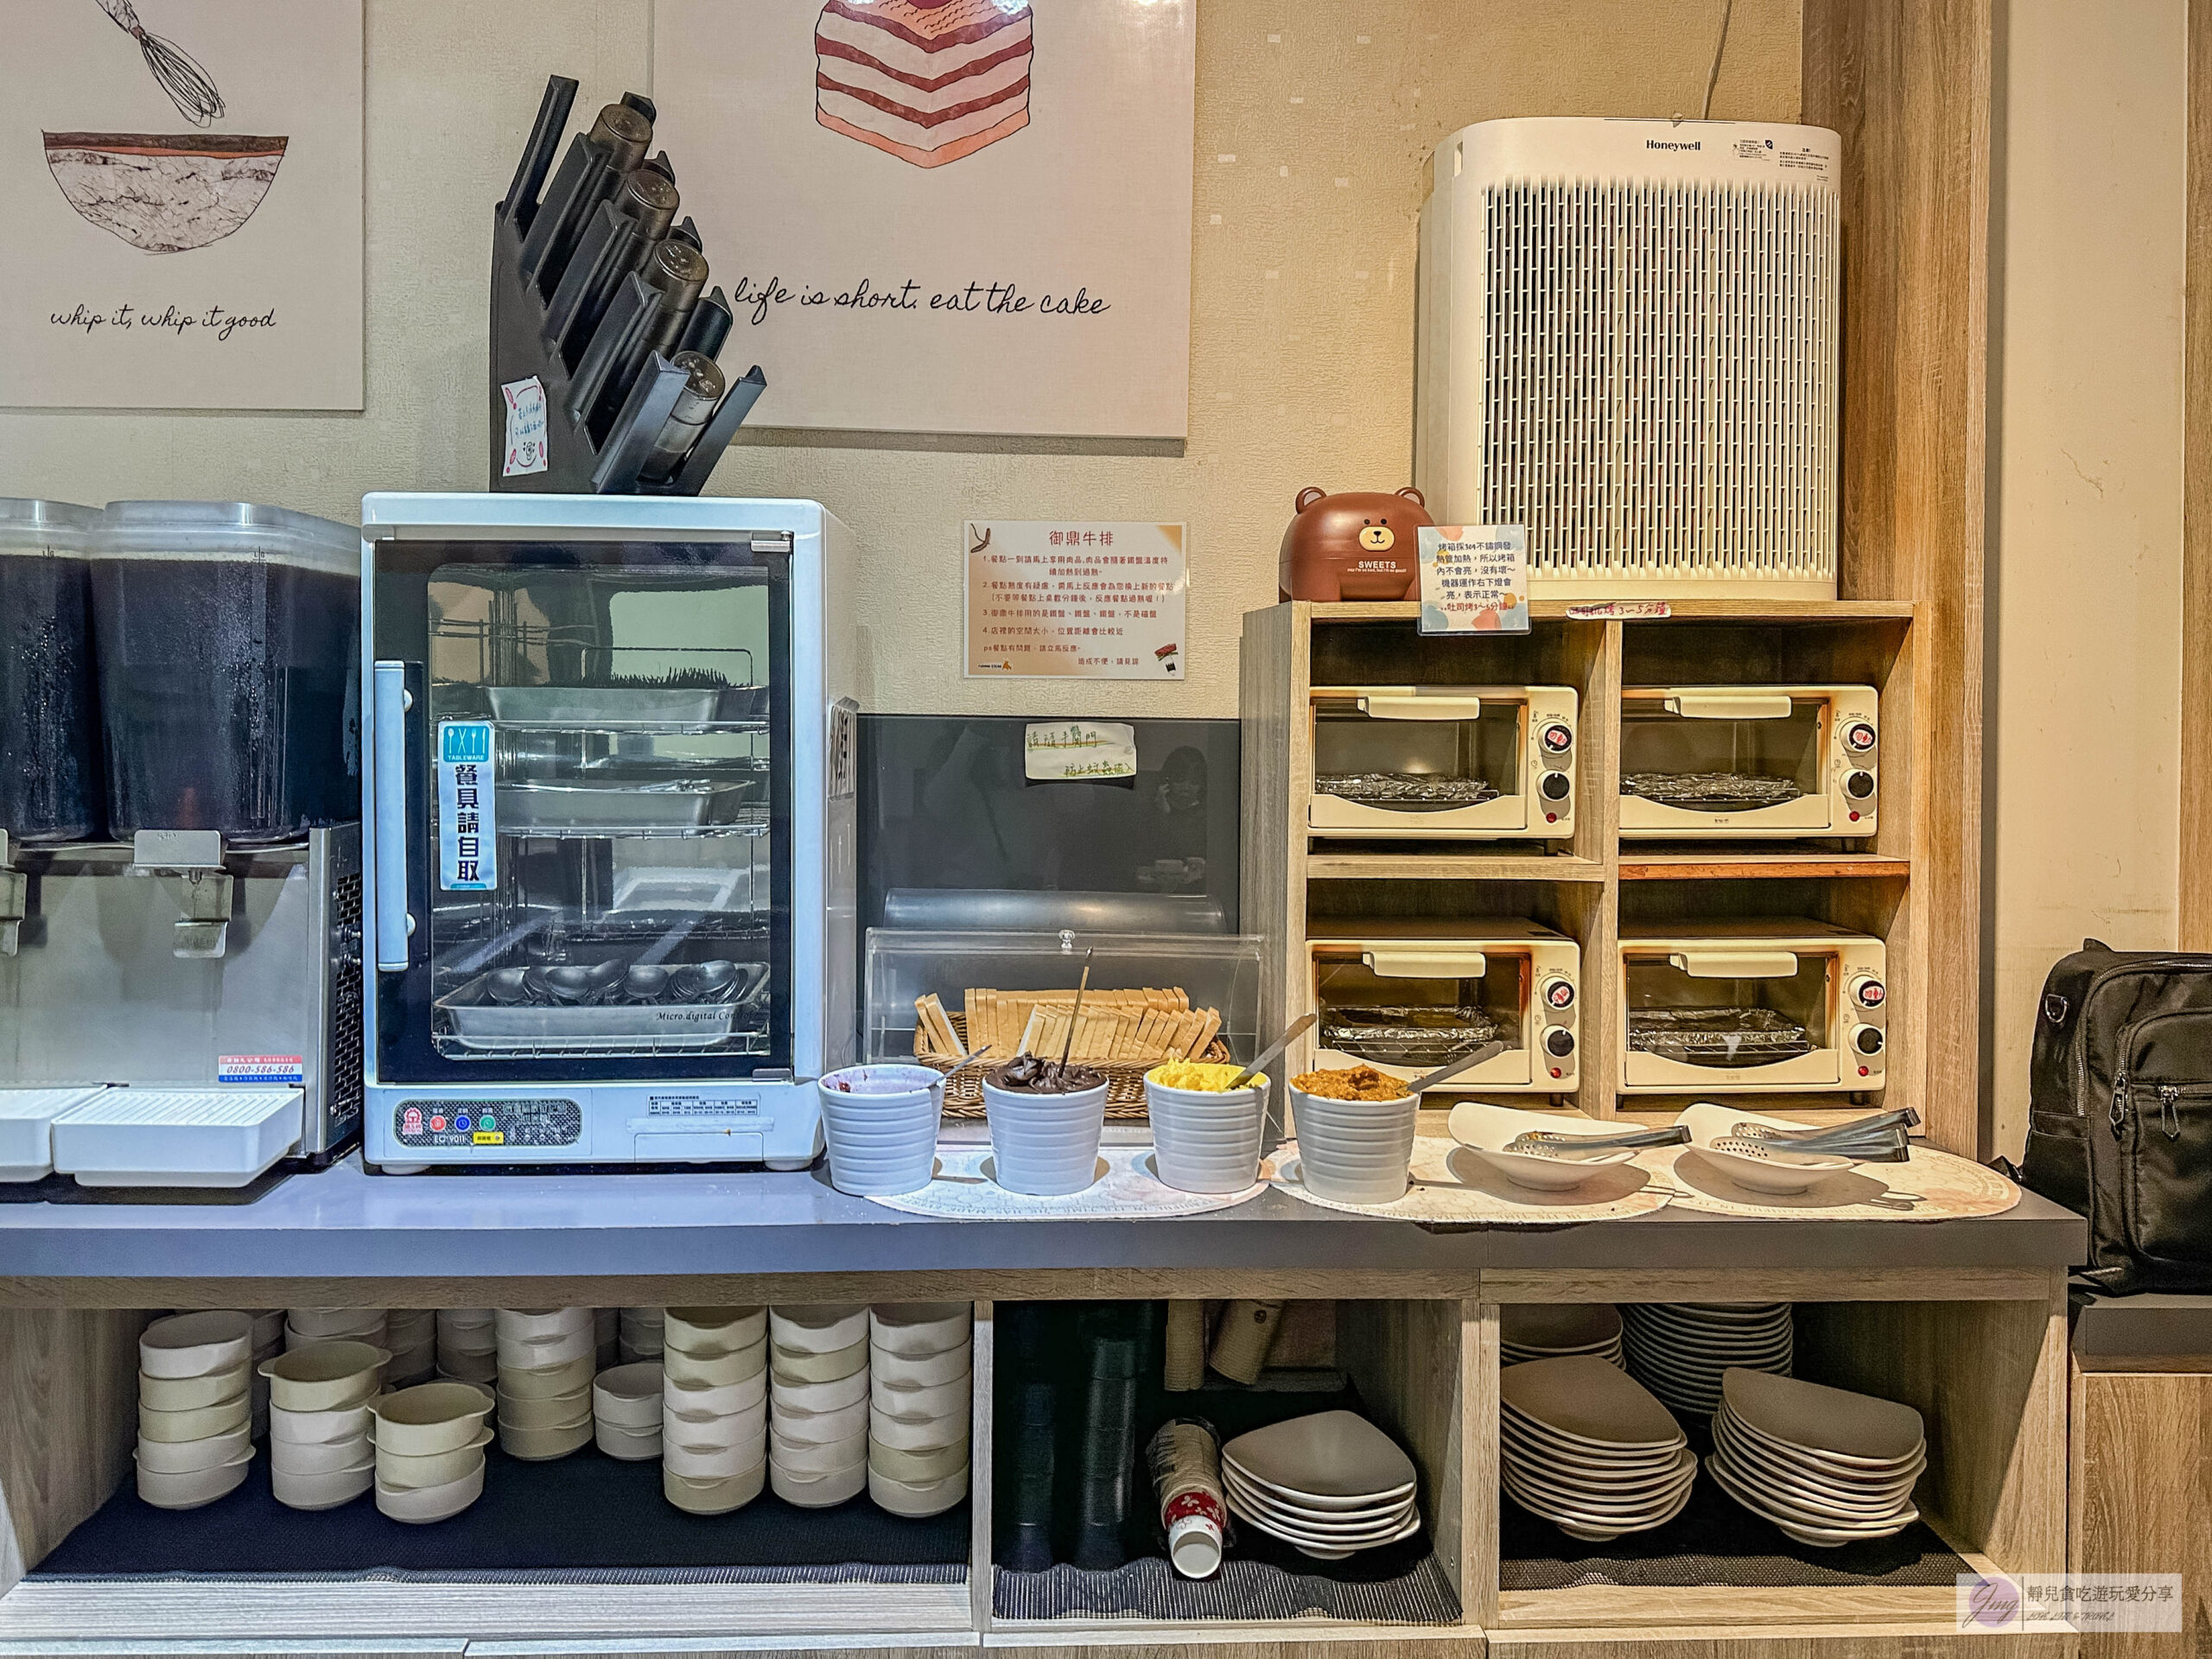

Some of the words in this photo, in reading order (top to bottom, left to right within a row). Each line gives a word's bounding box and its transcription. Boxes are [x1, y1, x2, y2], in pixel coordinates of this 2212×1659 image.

[1646, 139, 1701, 152] Honeywell
[734, 276, 796, 326] life
[800, 284, 833, 305] is
[929, 279, 984, 311] eat
[984, 282, 1035, 314] the
[1039, 287, 1112, 315] cake
[50, 303, 106, 334] whip
[141, 305, 196, 335] whip
[201, 305, 225, 327] it
[218, 308, 276, 341] good
[1049, 531, 1114, 546] 御鼎牛排
[1358, 561, 1396, 569] SWEETS
[1441, 578, 1512, 588] 機器運作右下燈會
[455, 764, 480, 881] 餐具請自取
[226, 1065, 295, 1074] 0800-586-586
